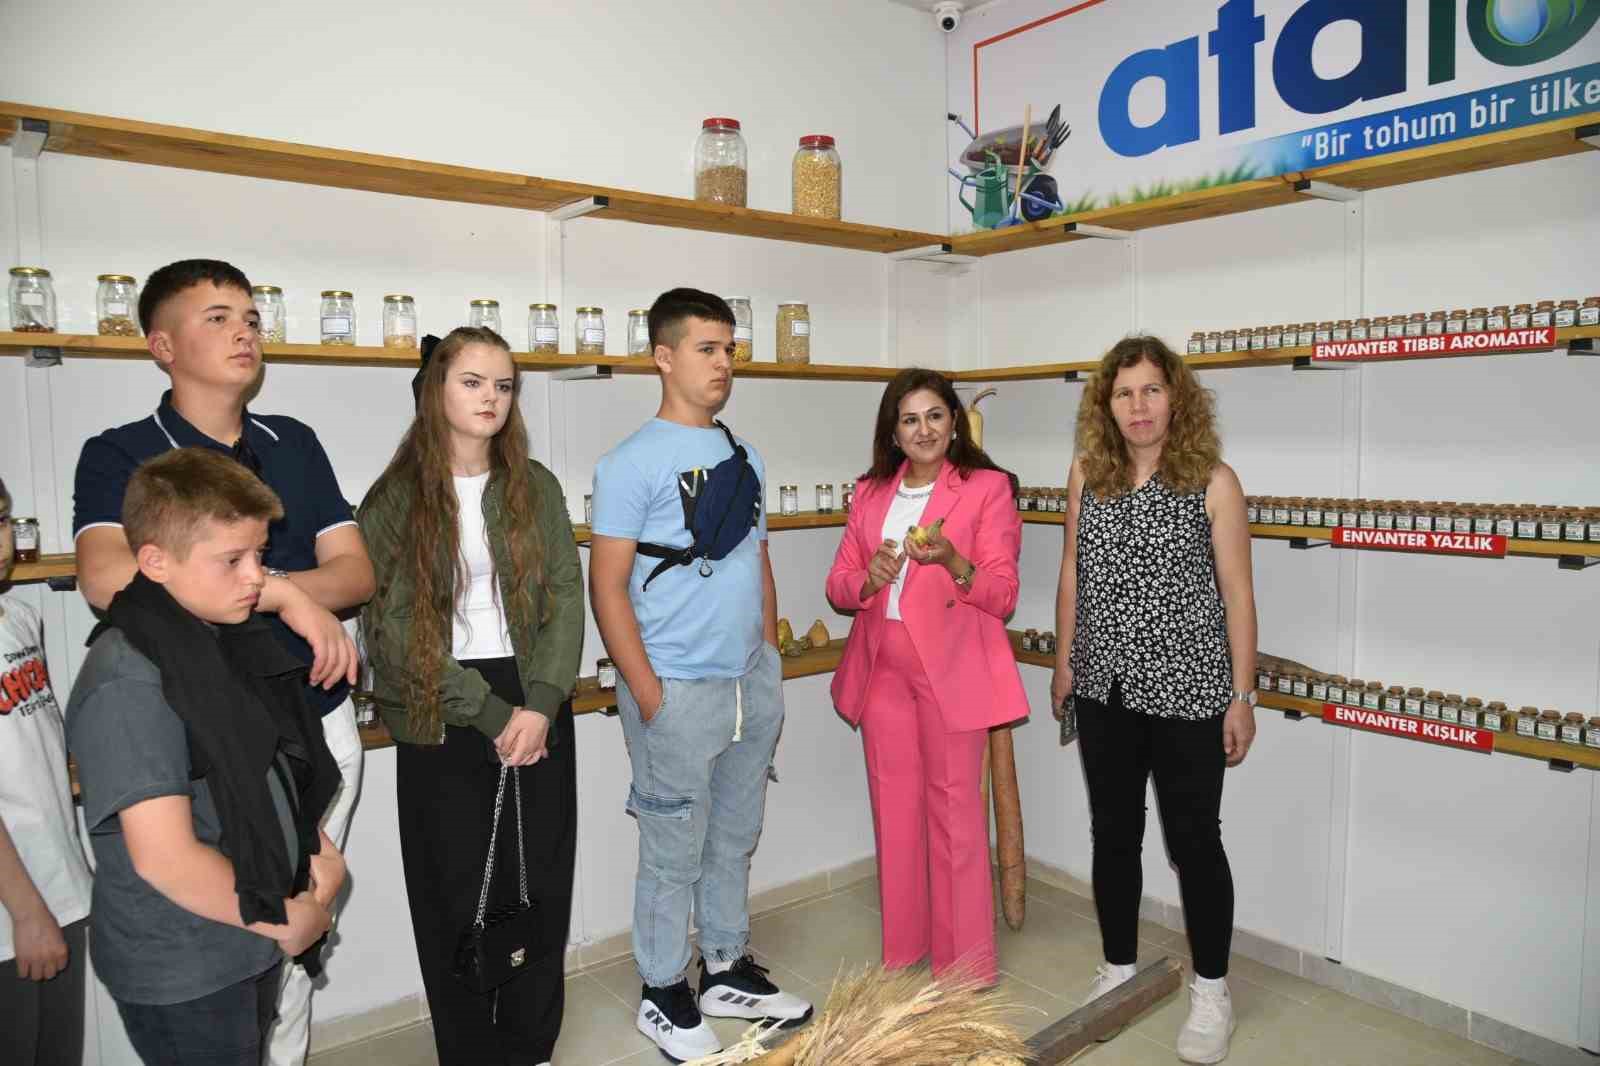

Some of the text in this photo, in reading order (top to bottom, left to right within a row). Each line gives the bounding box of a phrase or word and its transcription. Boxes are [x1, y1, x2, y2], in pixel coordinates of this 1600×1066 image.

[1363, 115, 1456, 150] tohum
[1470, 94, 1516, 129] bir
[1530, 77, 1600, 116] ülke
[1315, 340, 1398, 358] ENVANTER
[1342, 530, 1493, 550] ENVANTER YAZLIK
[1335, 707, 1417, 733] ENVANTER
[1422, 723, 1477, 744] KIŞLIK
